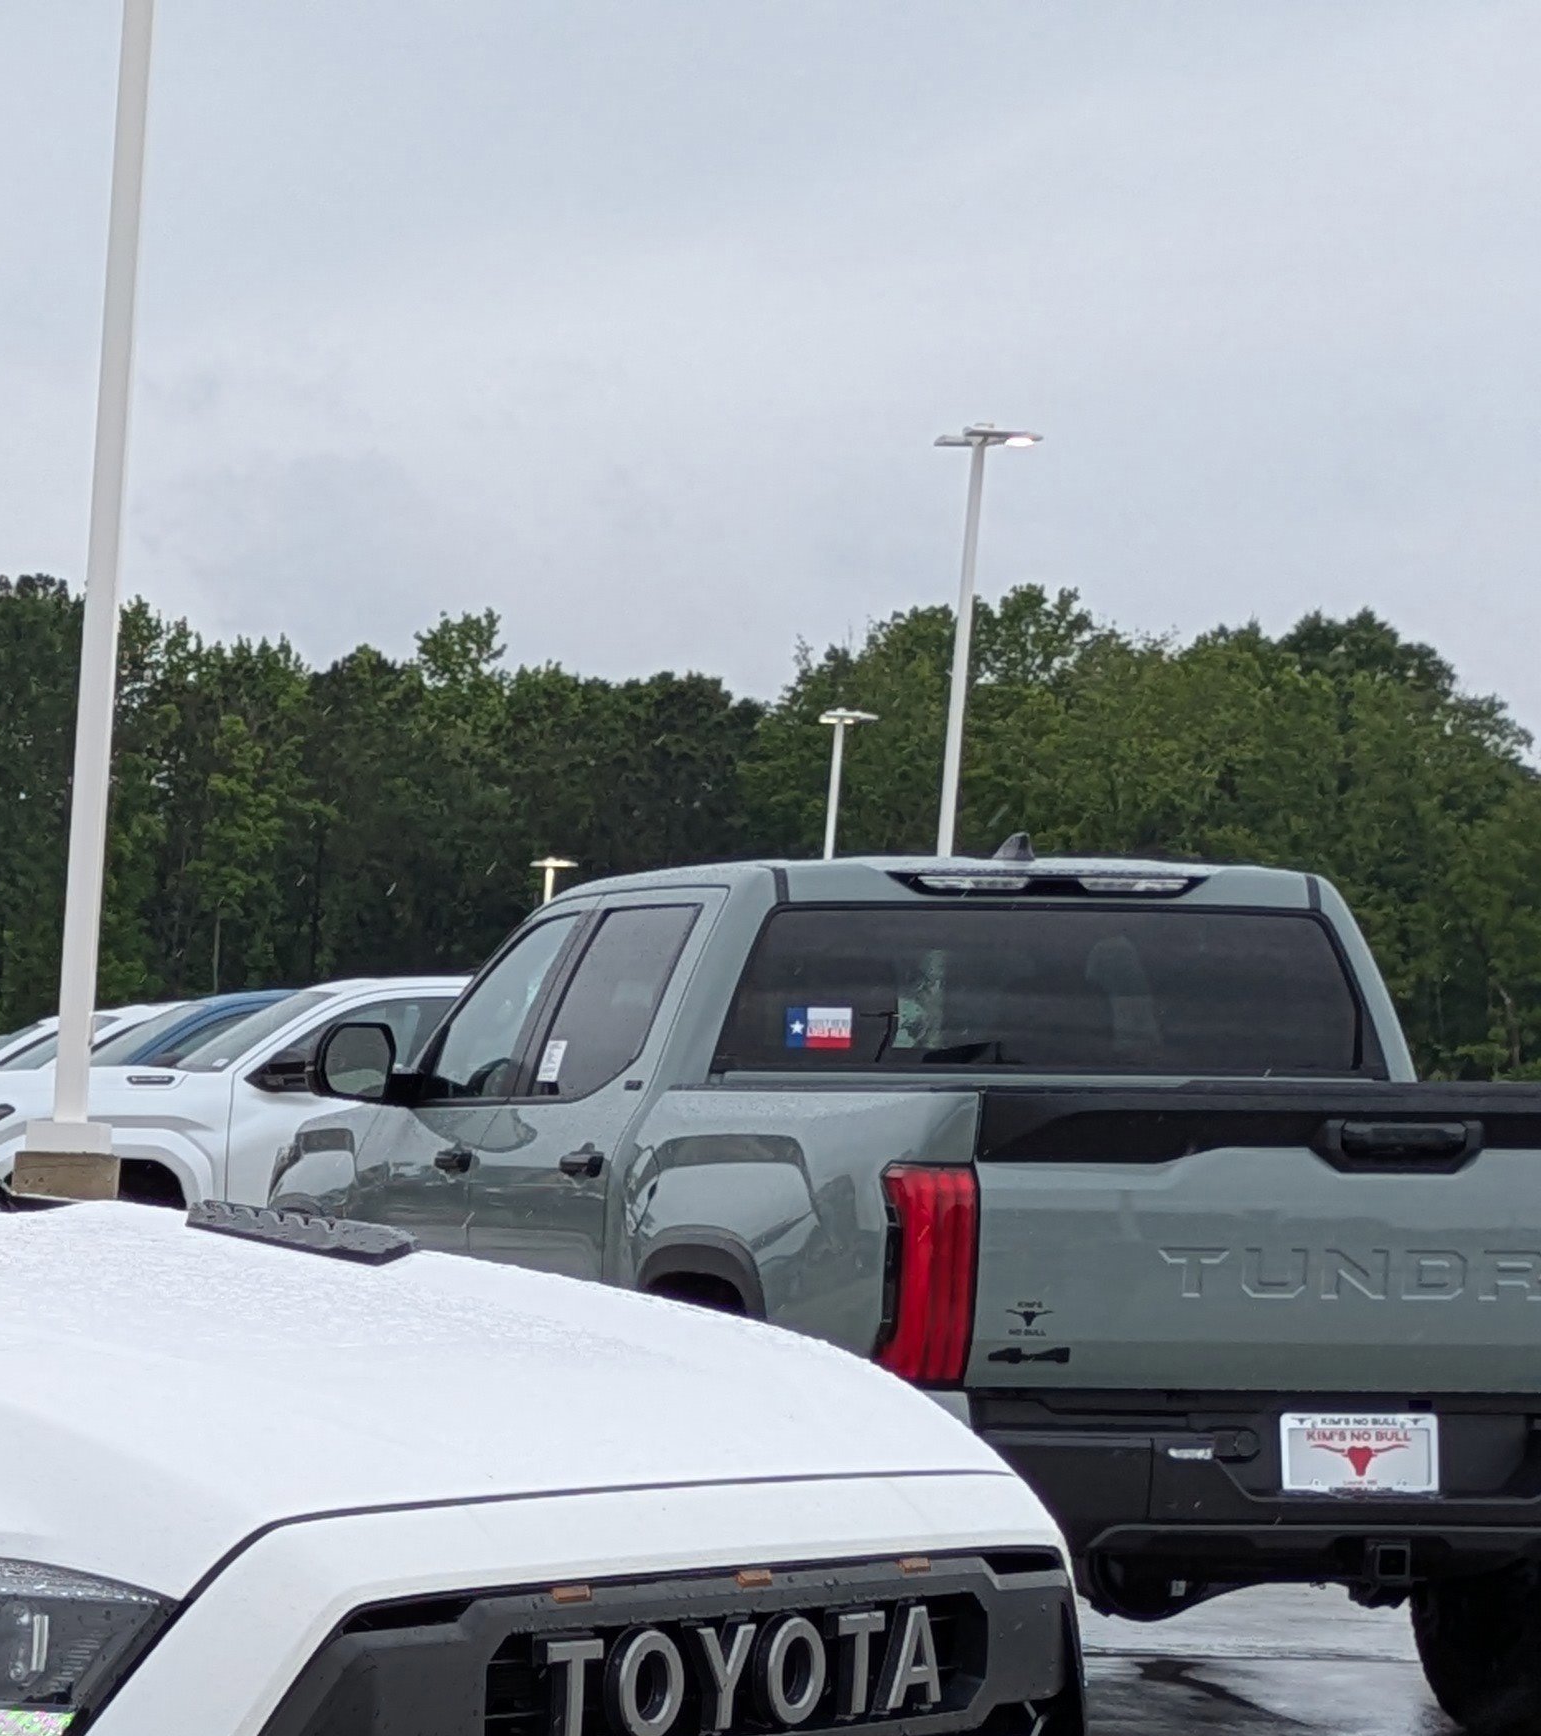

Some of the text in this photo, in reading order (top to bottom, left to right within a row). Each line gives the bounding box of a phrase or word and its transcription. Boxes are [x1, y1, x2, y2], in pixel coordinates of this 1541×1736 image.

[1305, 1430, 1412, 1442] KIM'S NO BULL
